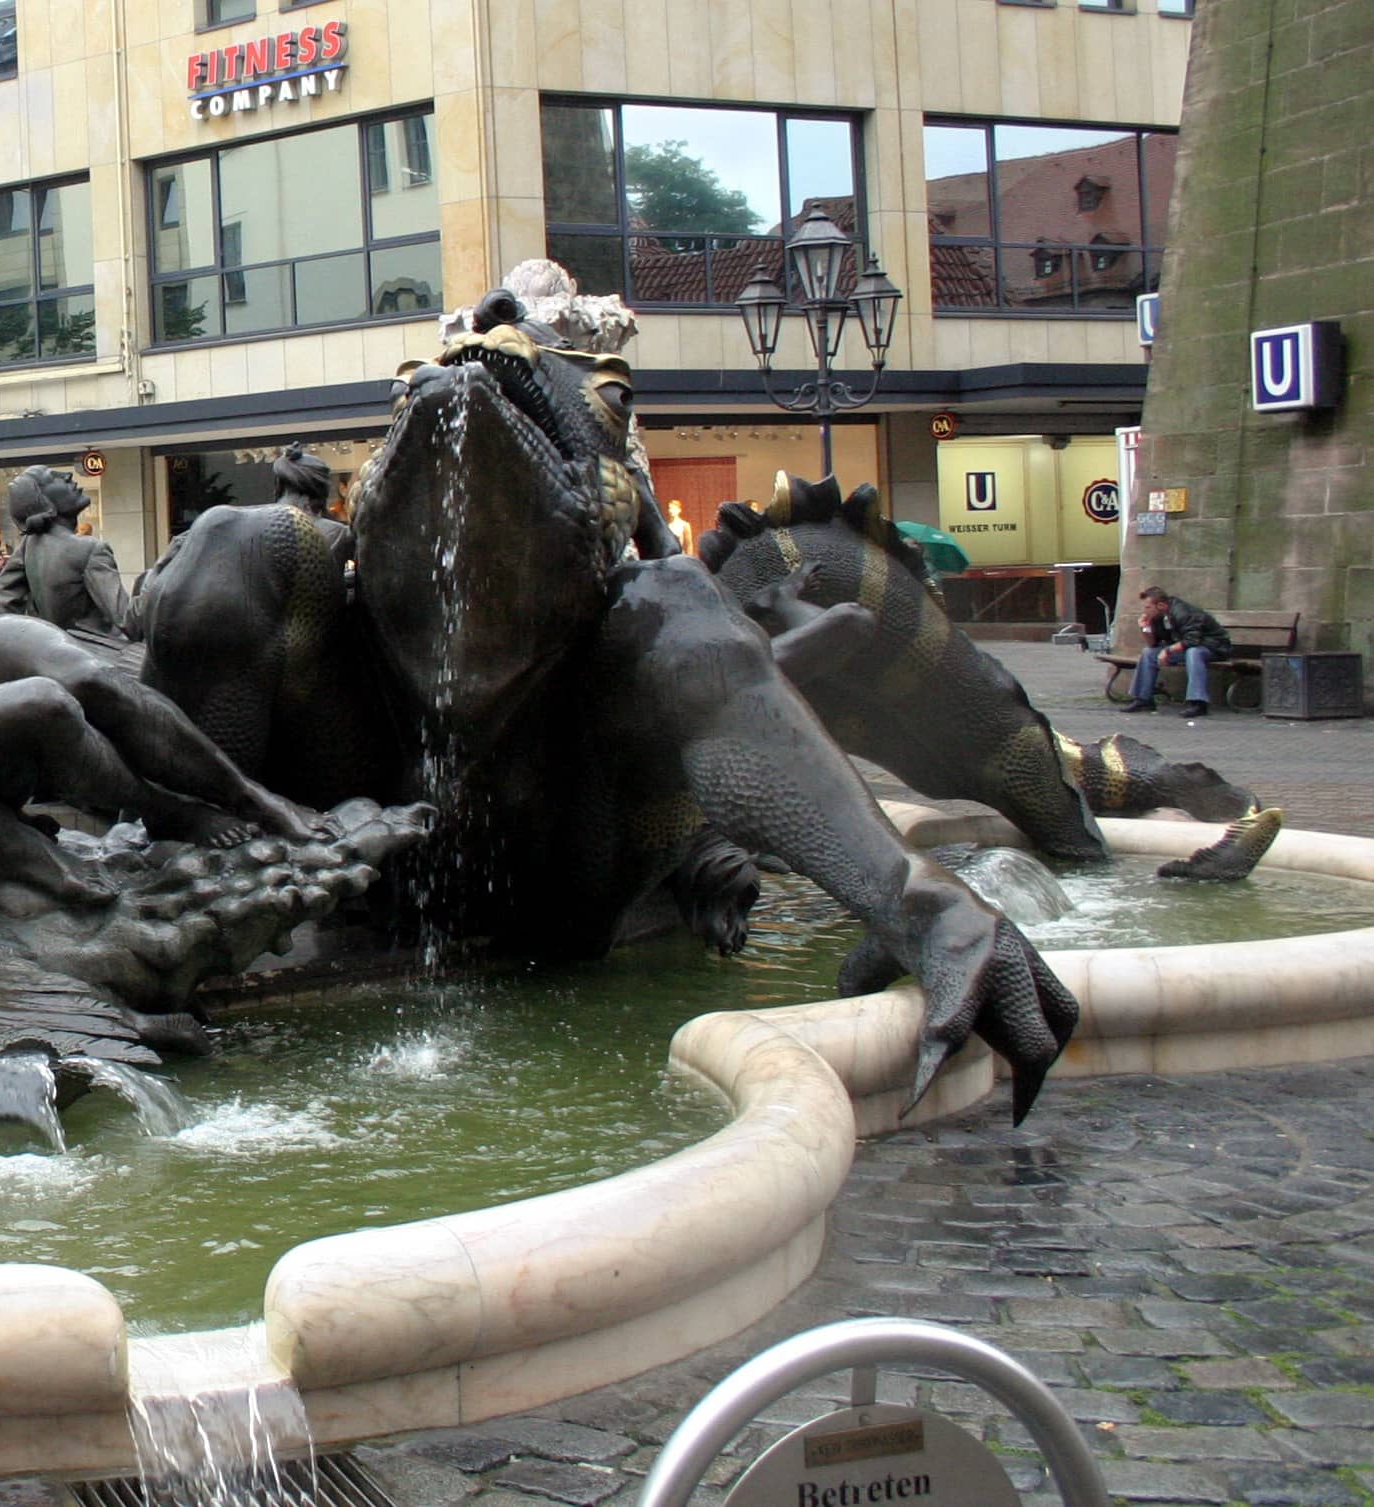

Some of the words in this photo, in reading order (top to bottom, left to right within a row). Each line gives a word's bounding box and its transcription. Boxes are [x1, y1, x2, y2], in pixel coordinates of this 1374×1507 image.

[187, 21, 343, 90] FITNESS
[190, 69, 339, 120] COMPANY
[1261, 338, 1293, 397] U
[968, 474, 994, 509] U
[948, 523, 989, 533] WEISSER
[992, 522, 1017, 532] TURM
[797, 1472, 931, 1507] Betreten
